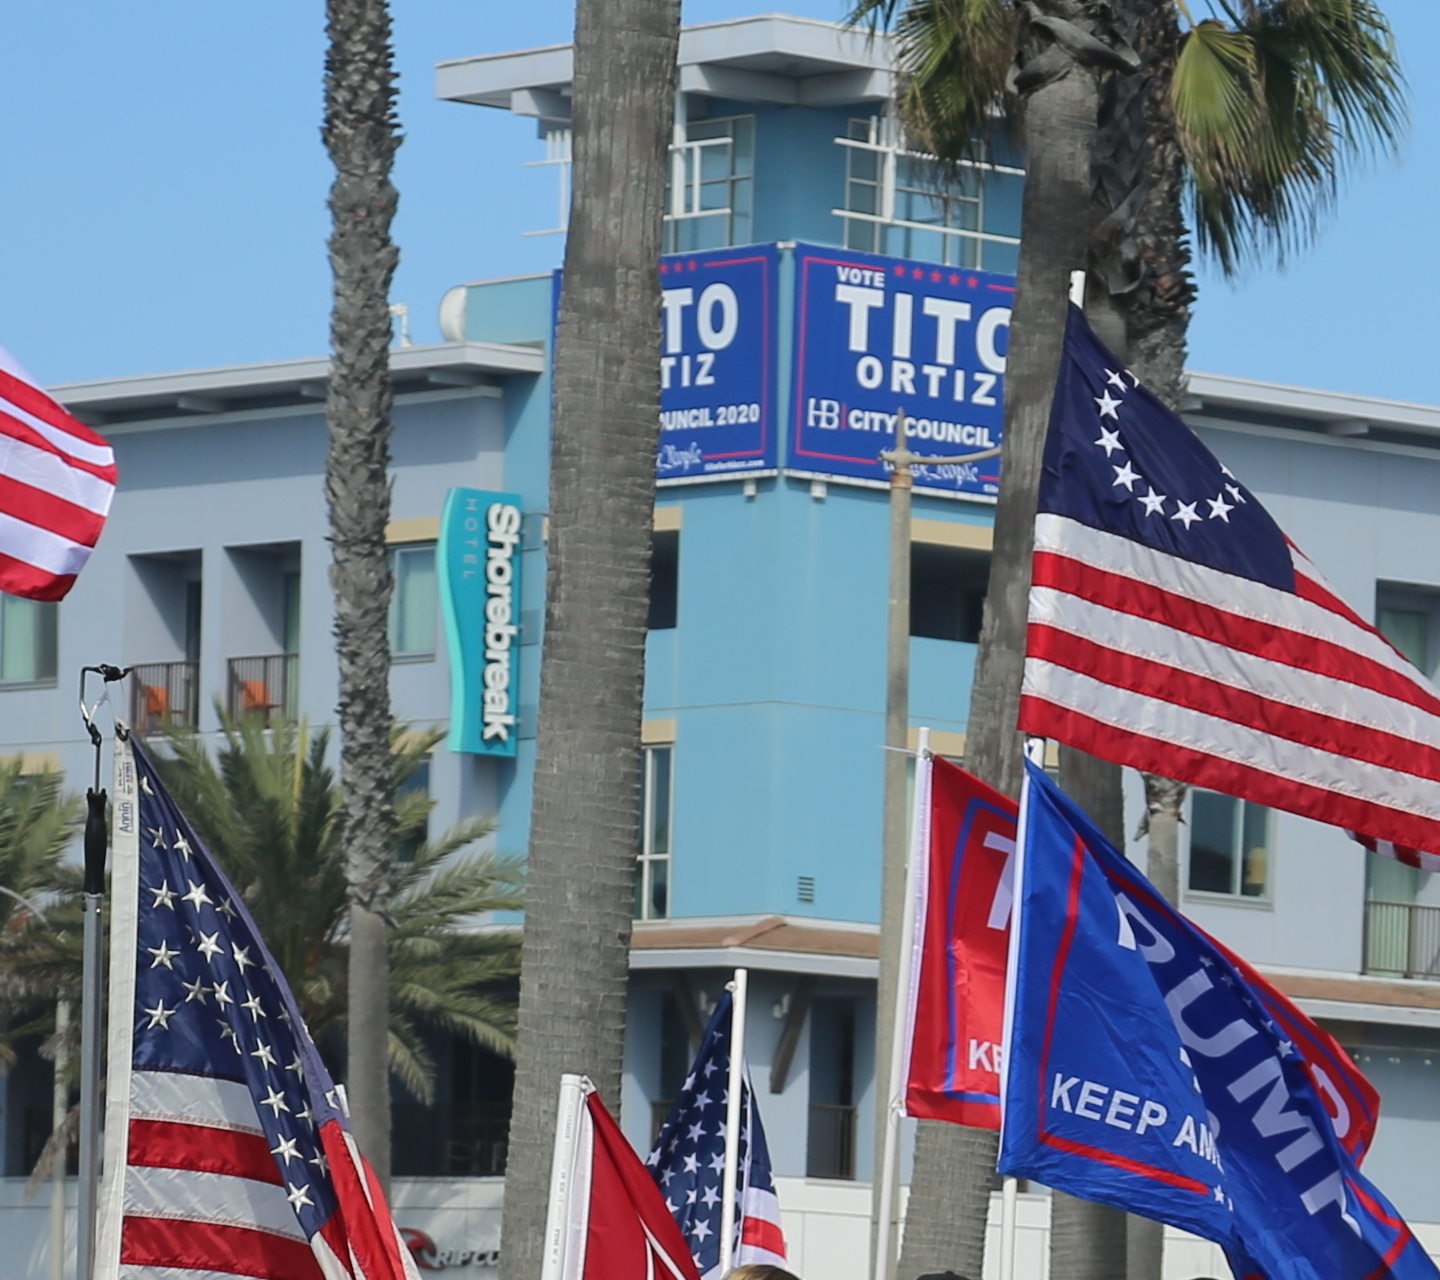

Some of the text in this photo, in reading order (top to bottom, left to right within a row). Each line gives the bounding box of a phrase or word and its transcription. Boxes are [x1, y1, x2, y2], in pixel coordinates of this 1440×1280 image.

[836, 265, 885, 288] VOTE
[662, 283, 739, 354] TO
[856, 356, 997, 407] ORTIZ
[716, 403, 761, 426] 2020
[847, 408, 898, 434] CITY
[903, 416, 994, 448] COUNCIL
[461, 496, 479, 581] HOTEL
[481, 501, 521, 742] Shorebreak
[1049, 1072, 1167, 1136] KEEP
